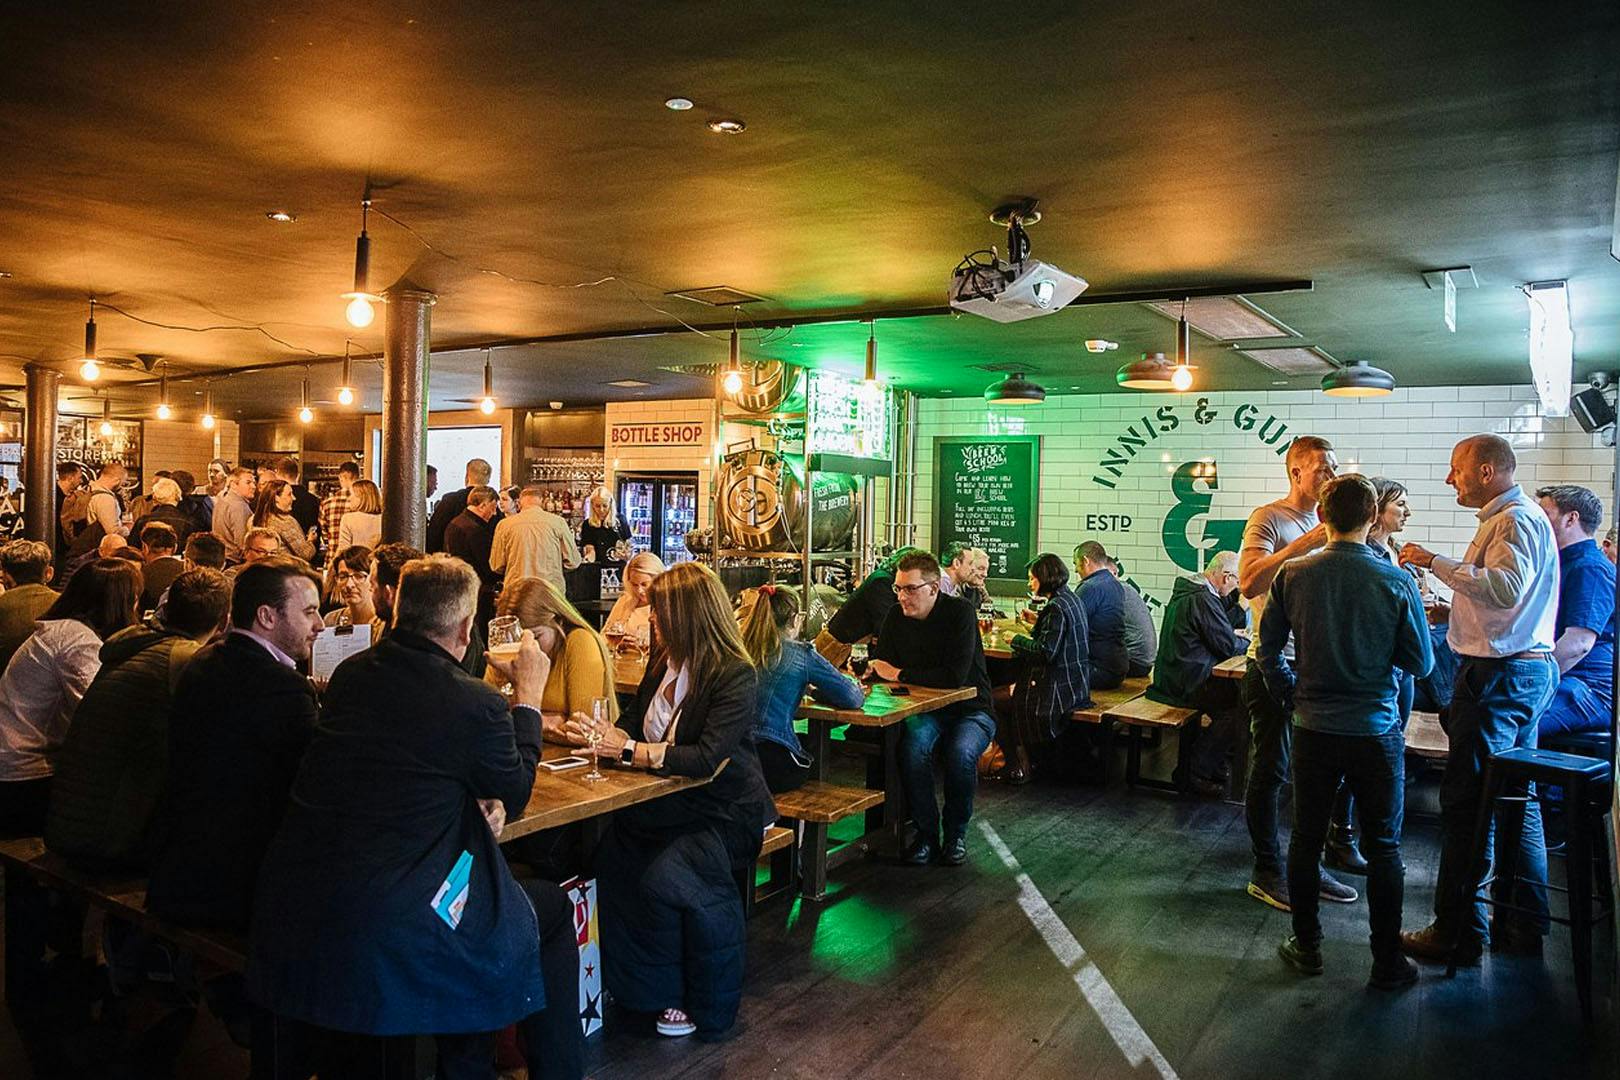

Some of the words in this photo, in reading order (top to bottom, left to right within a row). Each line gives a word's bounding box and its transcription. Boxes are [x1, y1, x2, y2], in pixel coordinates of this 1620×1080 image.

[611, 427, 660, 443] BOTTLE
[662, 426, 702, 442] SHOP
[1092, 406, 1180, 489] INNIS
[1194, 397, 1218, 425] &
[965, 453, 1004, 470] SCHOOL
[818, 500, 828, 511] THE
[828, 495, 849, 510] BREWERY
[1086, 514, 1132, 532] ESTD
